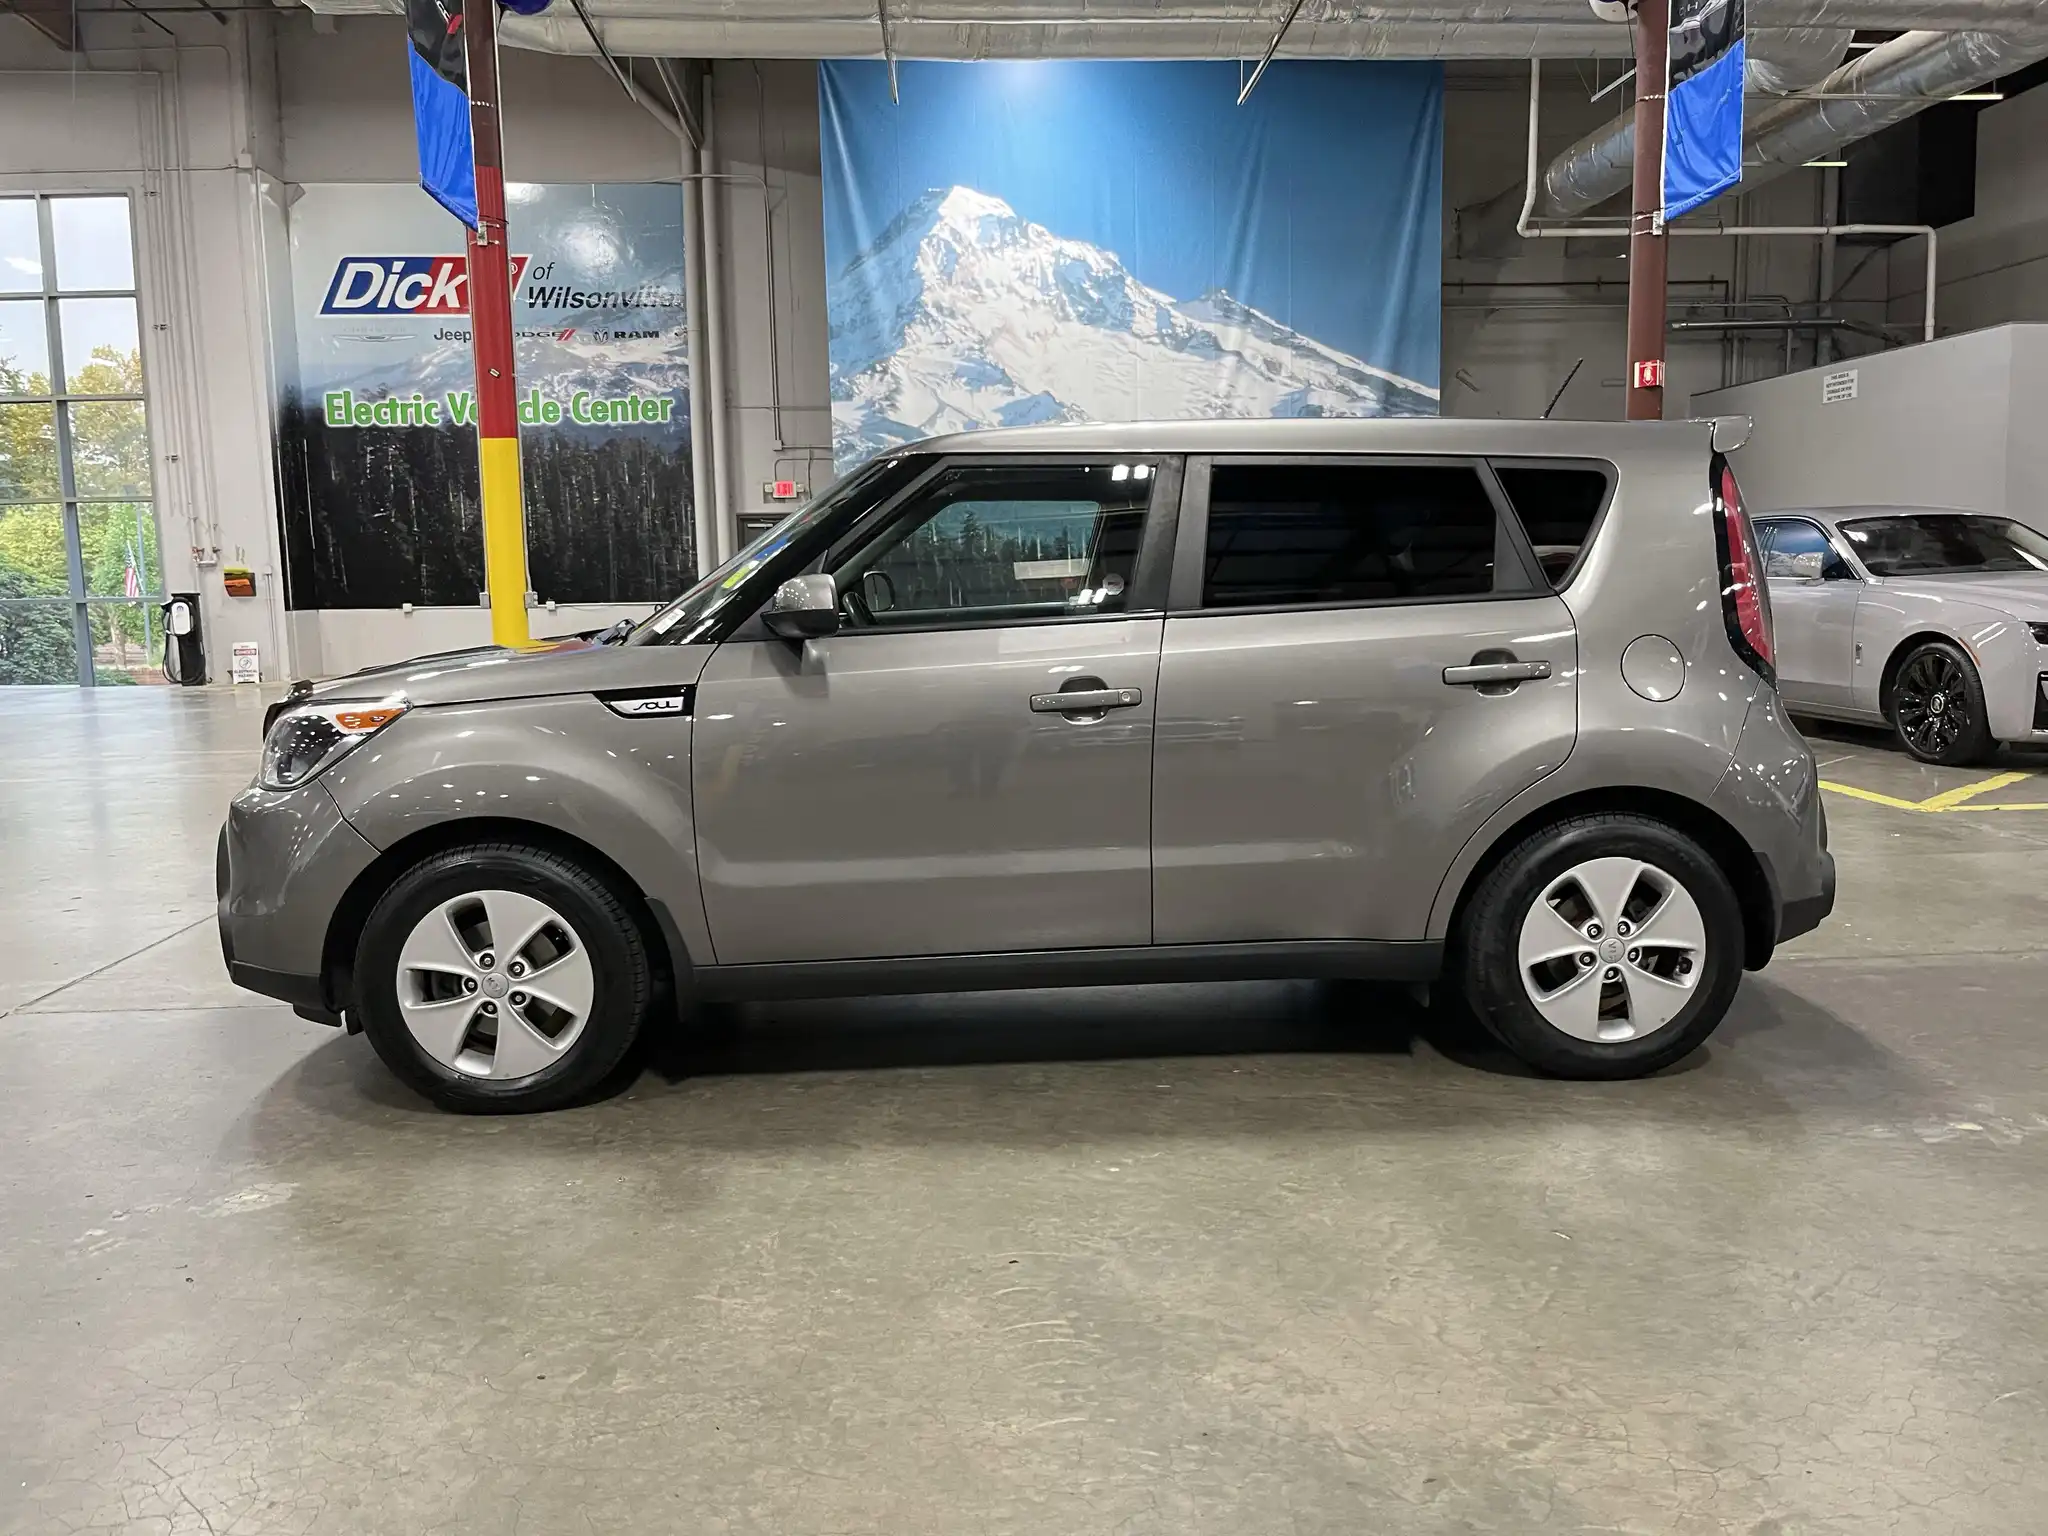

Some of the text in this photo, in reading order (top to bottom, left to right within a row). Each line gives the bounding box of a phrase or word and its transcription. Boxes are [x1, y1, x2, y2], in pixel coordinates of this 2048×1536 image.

[533, 262, 555, 280] of
[434, 327, 472, 343] Jeep
[614, 330, 660, 338] RAM
[326, 389, 675, 425] Electric Vcle Center
[633, 701, 679, 710] SOUL
